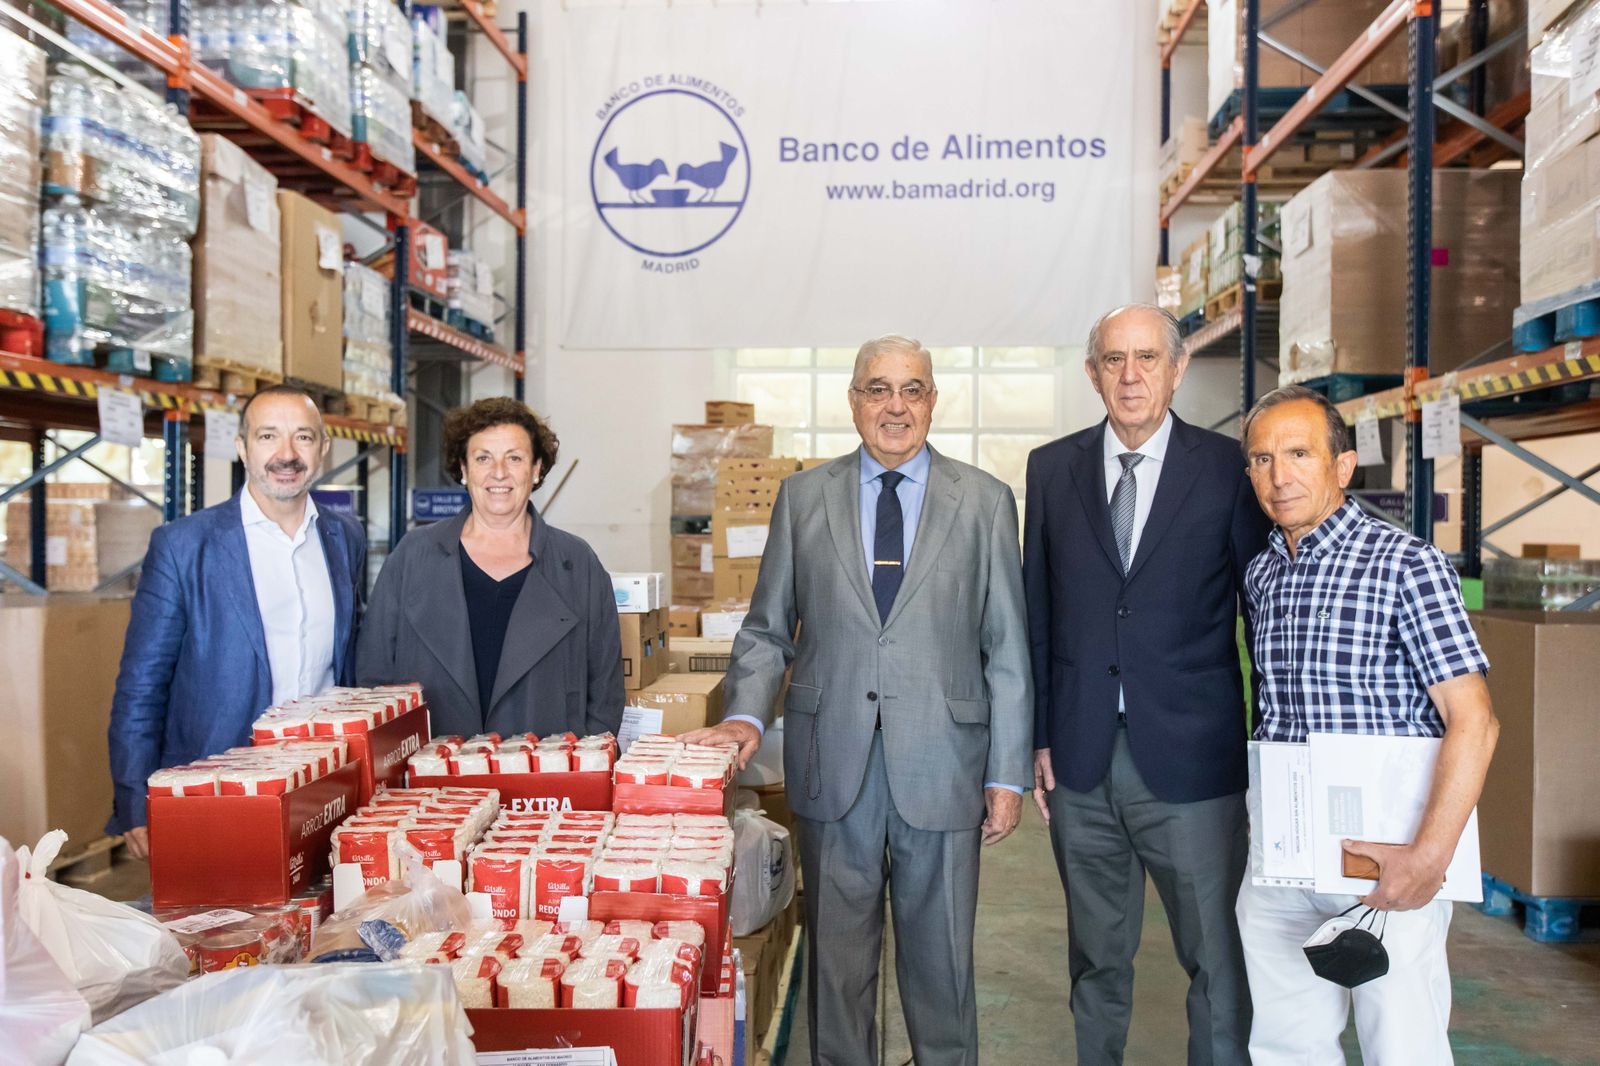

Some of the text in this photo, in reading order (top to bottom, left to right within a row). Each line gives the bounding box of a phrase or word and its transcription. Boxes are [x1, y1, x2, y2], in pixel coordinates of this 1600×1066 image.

[596, 74, 746, 121] BANCO DE ALIMENTOS
[779, 134, 1106, 163] Banco de Alimentos
[826, 179, 1056, 202] www.bamadrid.org
[641, 258, 700, 274] MADRID
[384, 732, 420, 769] ARROZ EXTRA
[511, 796, 573, 812] EXTRA
[301, 794, 346, 840] ARROZ EXTRA
[492, 908, 517, 918] ONDO
[538, 904, 560, 915] REDO
